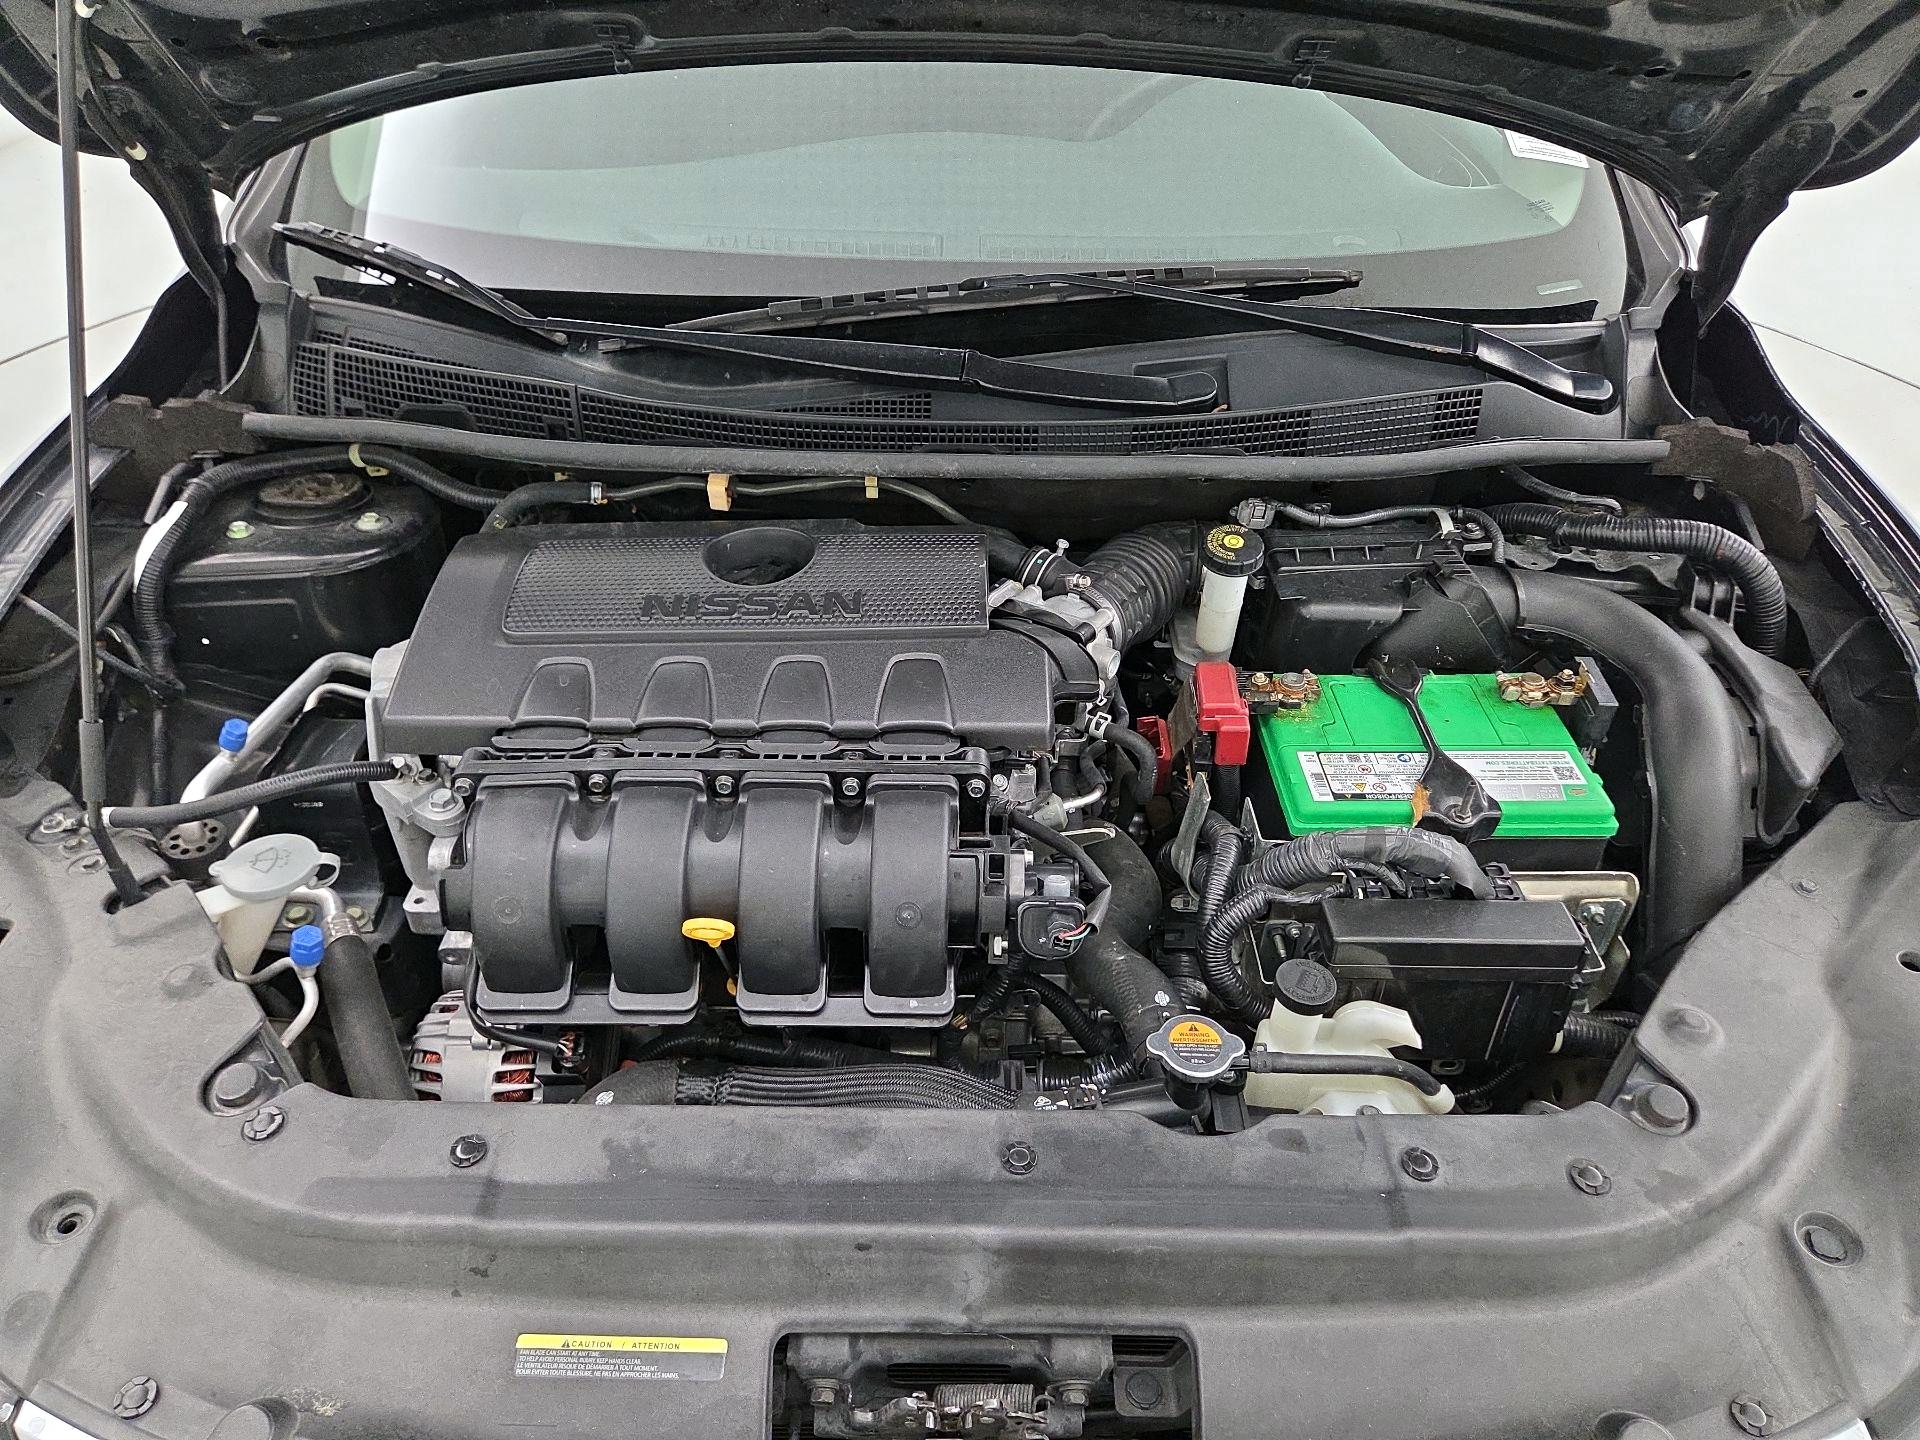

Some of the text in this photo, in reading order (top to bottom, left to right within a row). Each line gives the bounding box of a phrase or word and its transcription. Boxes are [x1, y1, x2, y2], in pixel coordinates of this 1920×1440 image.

[640, 592, 863, 620] NISSAN
[632, 1342, 680, 1350] ATTENTION
[620, 1371, 652, 1379] APPROCHER
